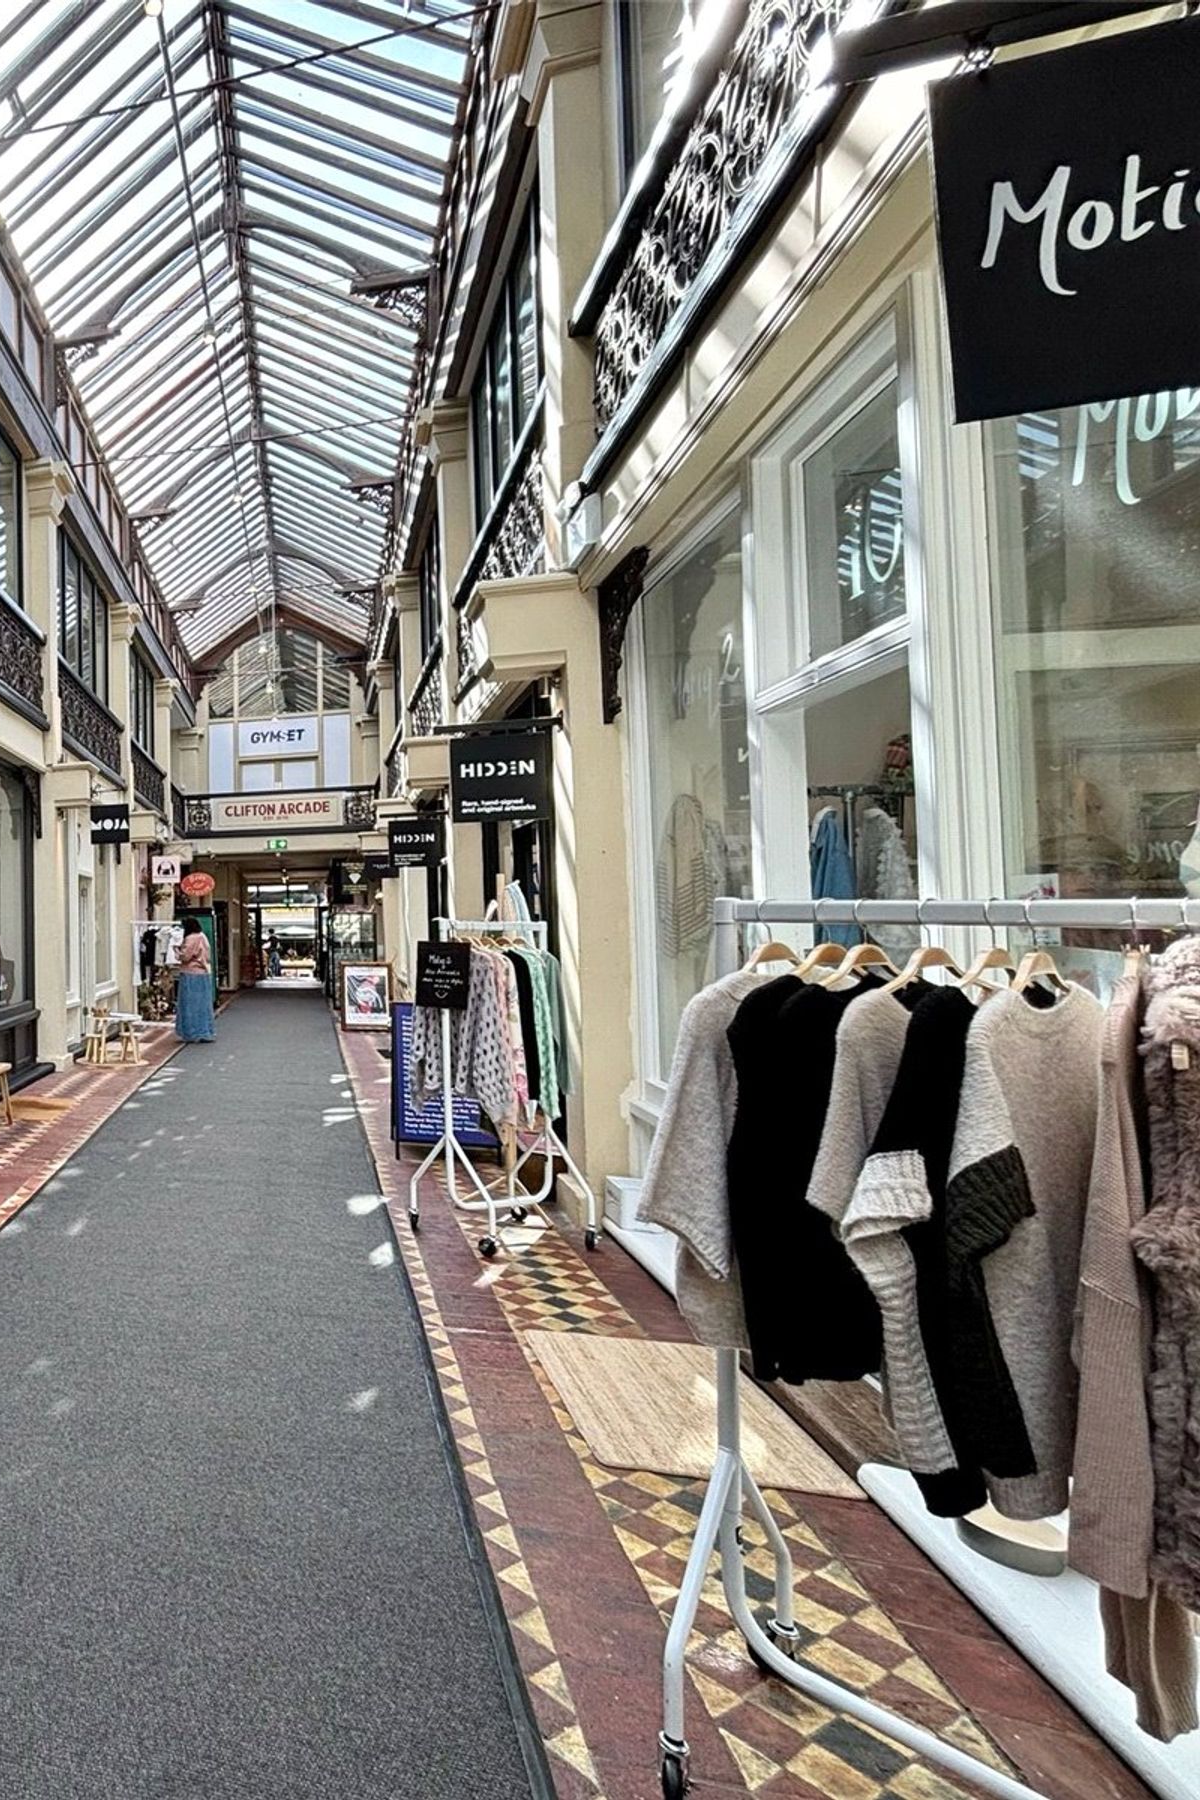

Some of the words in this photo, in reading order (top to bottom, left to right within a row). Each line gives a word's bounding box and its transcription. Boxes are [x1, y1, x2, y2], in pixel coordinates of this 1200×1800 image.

[980, 154, 1200, 296] Moti
[460, 759, 535, 778] HIDDEN
[224, 803, 276, 818] CLIFTON
[279, 800, 330, 816] ARCADE
[90, 818, 129, 831] MOJA
[393, 833, 435, 844] HIDDEN
